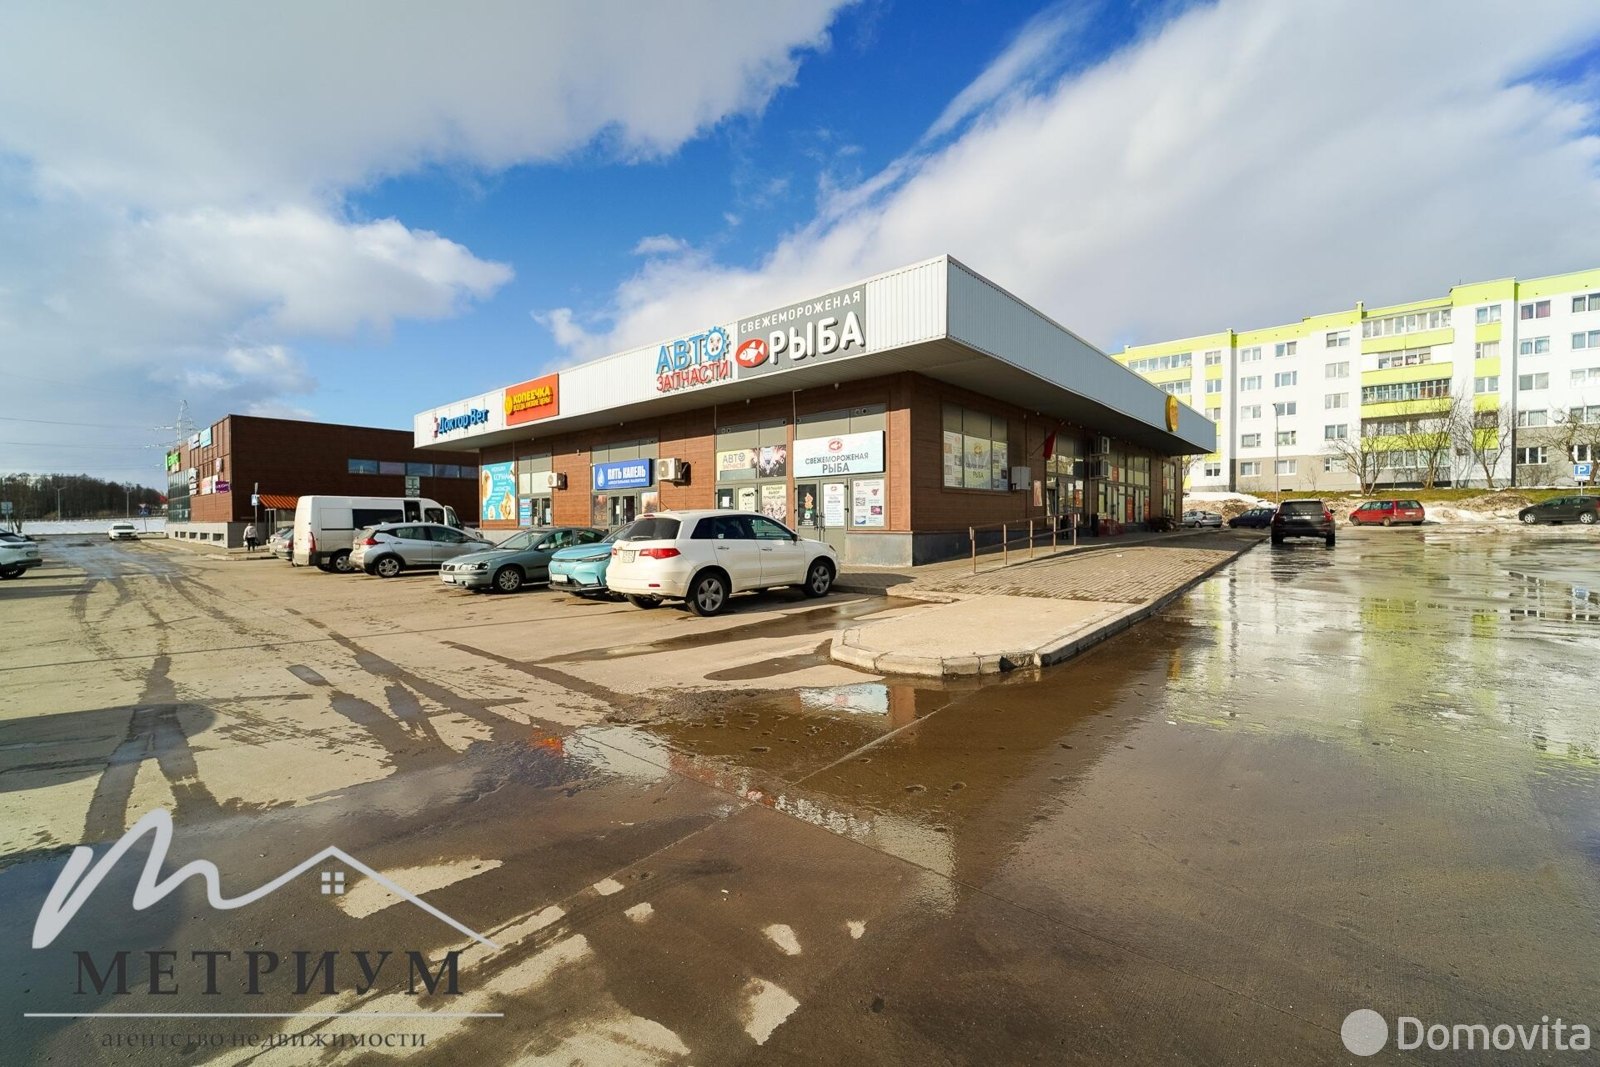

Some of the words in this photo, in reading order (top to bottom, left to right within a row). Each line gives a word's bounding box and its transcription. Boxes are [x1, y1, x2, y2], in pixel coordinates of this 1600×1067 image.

[741, 290, 861, 334] СВЕЖЕМОРОЖЕНАЯ
[769, 310, 864, 364] РЫБА
[656, 326, 727, 374] АВТО
[656, 359, 730, 391] ЗАПЧАСТИ
[513, 386, 552, 405] КОПЕЕЧКА
[438, 414, 469, 433] Доктор
[470, 408, 489, 425] Вет
[805, 452, 869, 465] СВЕЖЕМОРОЖЕНАЯ
[822, 462, 850, 474] РЫБА
[623, 465, 646, 479] КАПЕЛЬ
[1578, 465, 1587, 475] P
